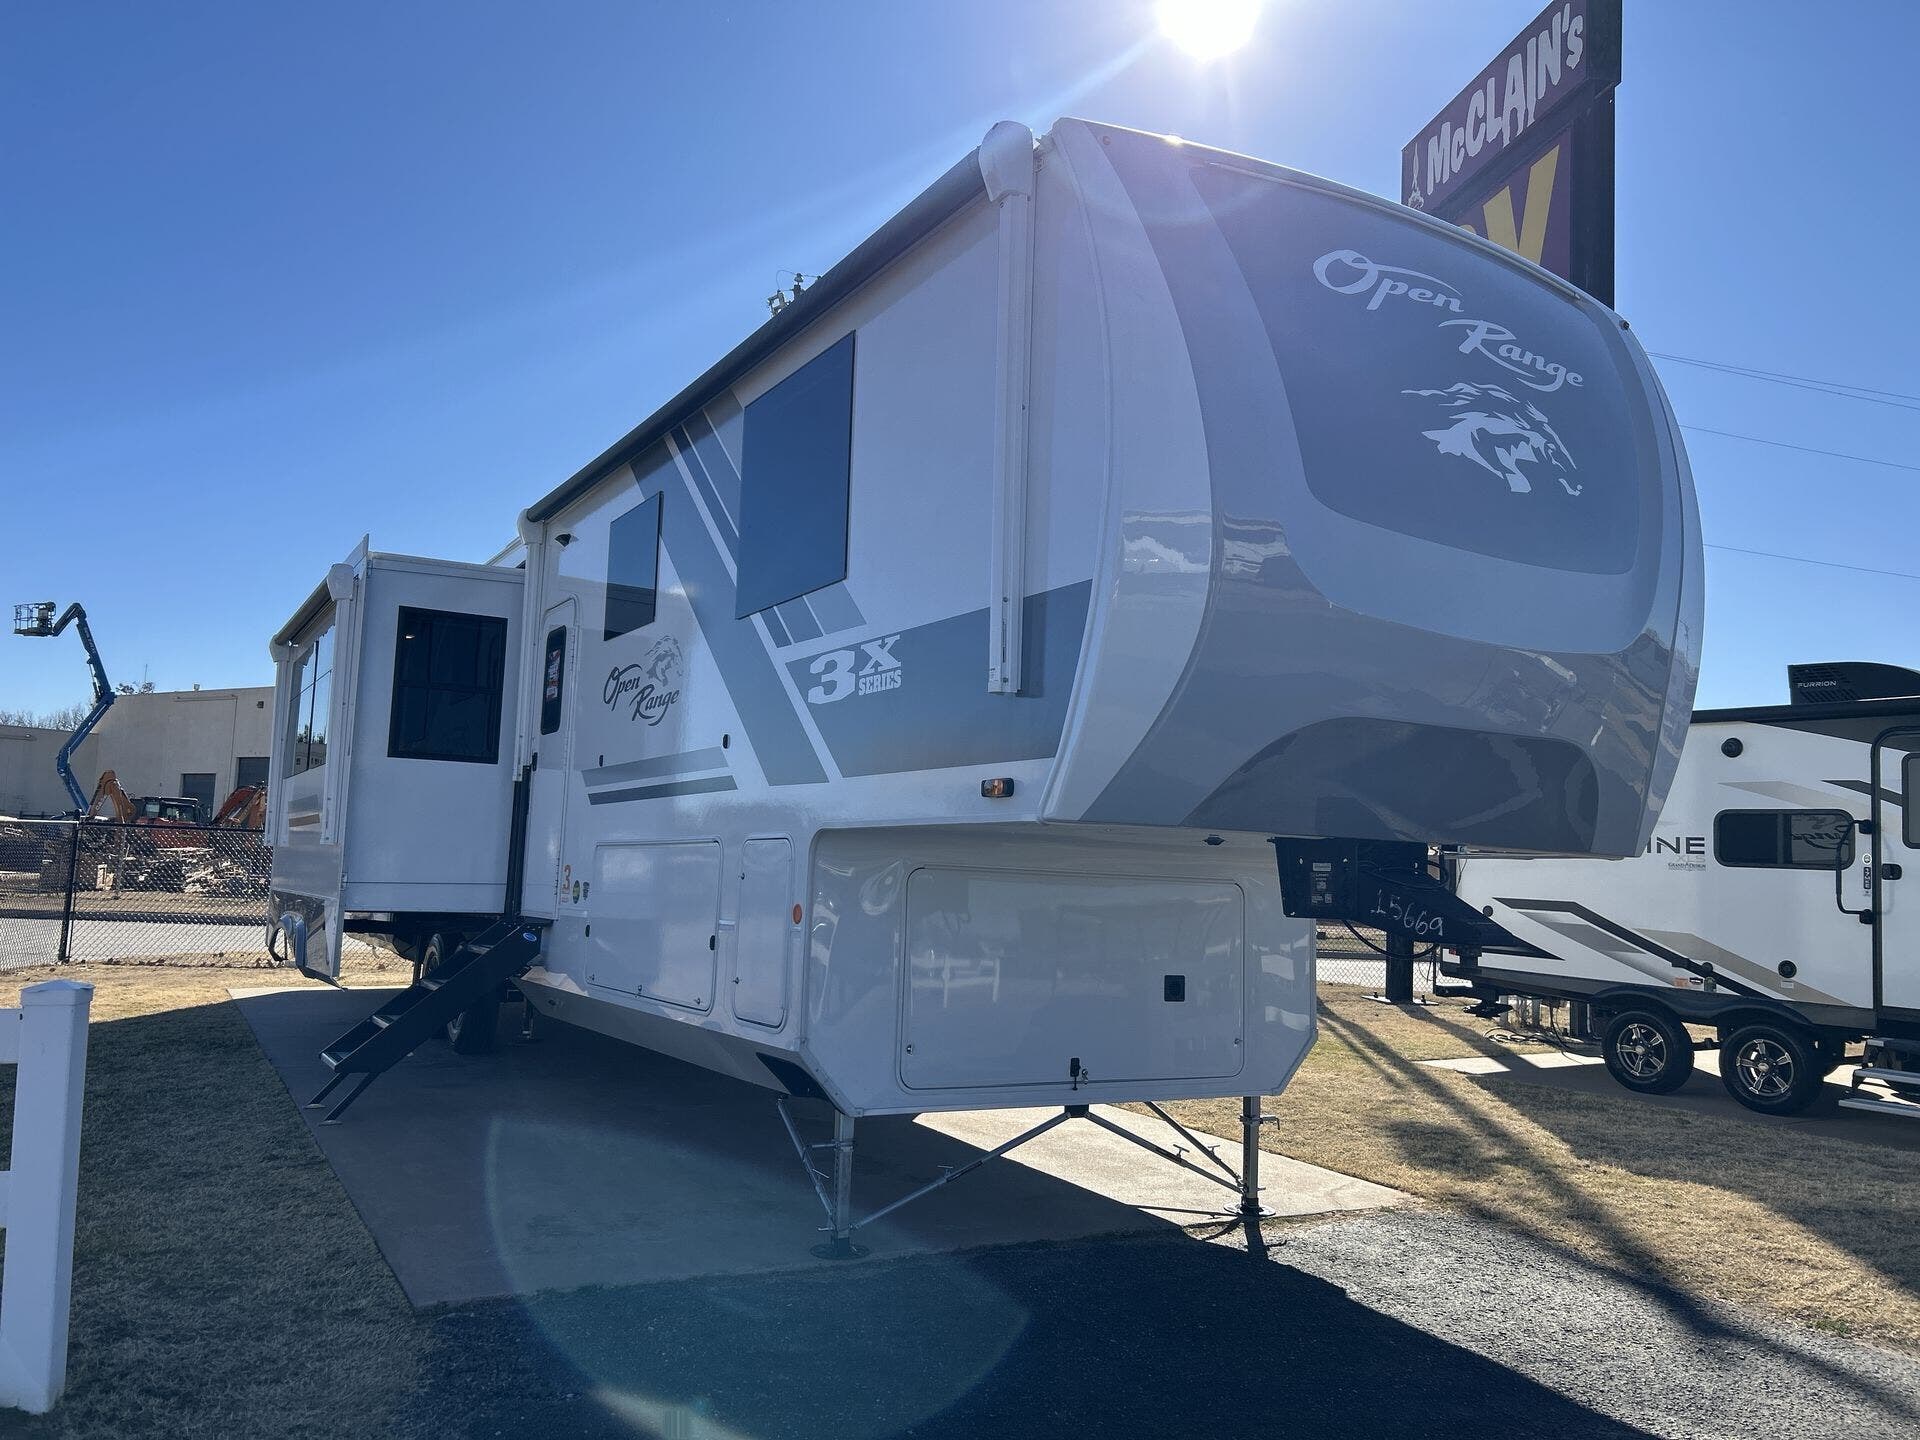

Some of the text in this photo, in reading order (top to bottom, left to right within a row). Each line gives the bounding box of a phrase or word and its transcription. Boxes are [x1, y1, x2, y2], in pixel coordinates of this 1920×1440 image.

[1426, 3, 1584, 196] McCLAIN's
[1312, 249, 1464, 313] Open
[1438, 319, 1584, 393] Range
[603, 663, 642, 712] Open
[629, 684, 680, 726] Range
[858, 669, 902, 696] SERIES
[1797, 680, 1837, 688] FURRION
[1370, 888, 1444, 937] 15669
